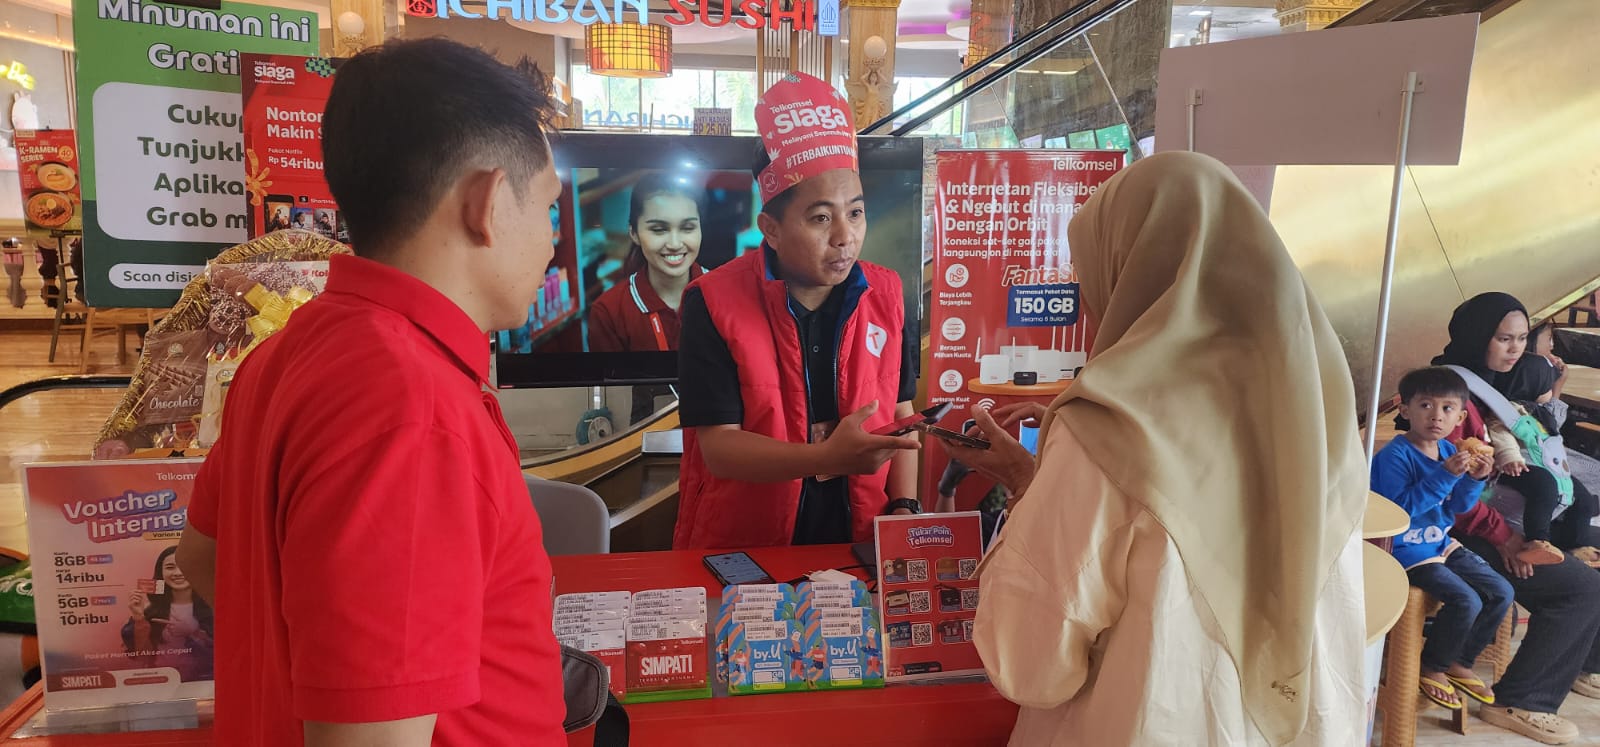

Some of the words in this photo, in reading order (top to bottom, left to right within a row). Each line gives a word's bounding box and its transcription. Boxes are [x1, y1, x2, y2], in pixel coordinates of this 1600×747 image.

[98, 0, 263, 36] Minuman
[270, 13, 310, 42] ini
[664, 0, 815, 32] SUSHI
[770, 98, 814, 114] Telkomsel
[267, 124, 315, 139] Makin
[19, 146, 58, 155] K-RAMEN
[268, 155, 280, 164] Rp
[280, 156, 324, 170] 54ribu
[1053, 157, 1117, 172] Telkomsel
[154, 172, 244, 197] Aplika
[946, 181, 1031, 196] Internetan
[945, 199, 959, 214] &
[962, 199, 1020, 217] Ngebut
[147, 206, 218, 228] Grab
[945, 217, 1004, 235] Dengan
[1007, 216, 1047, 232] Orbit
[944, 236, 981, 246] Koneksi
[943, 248, 989, 260] langsung
[124, 270, 162, 283] Scan
[165, 270, 196, 284] disi
[1014, 297, 1045, 314] 150
[1047, 297, 1074, 314] GB
[150, 394, 200, 410] Chocolate
[63, 489, 173, 520] Voucher
[909, 536, 952, 546] Telkomsel
[55, 555, 86, 567] 8GB
[56, 572, 105, 584] 14ribu
[58, 597, 89, 609] 5GB
[60, 613, 109, 626] 10ribu
[754, 641, 781, 661] by.U
[830, 638, 858, 657] by.U
[641, 654, 693, 676] SIMPATI
[62, 675, 102, 688] SIMPATI
